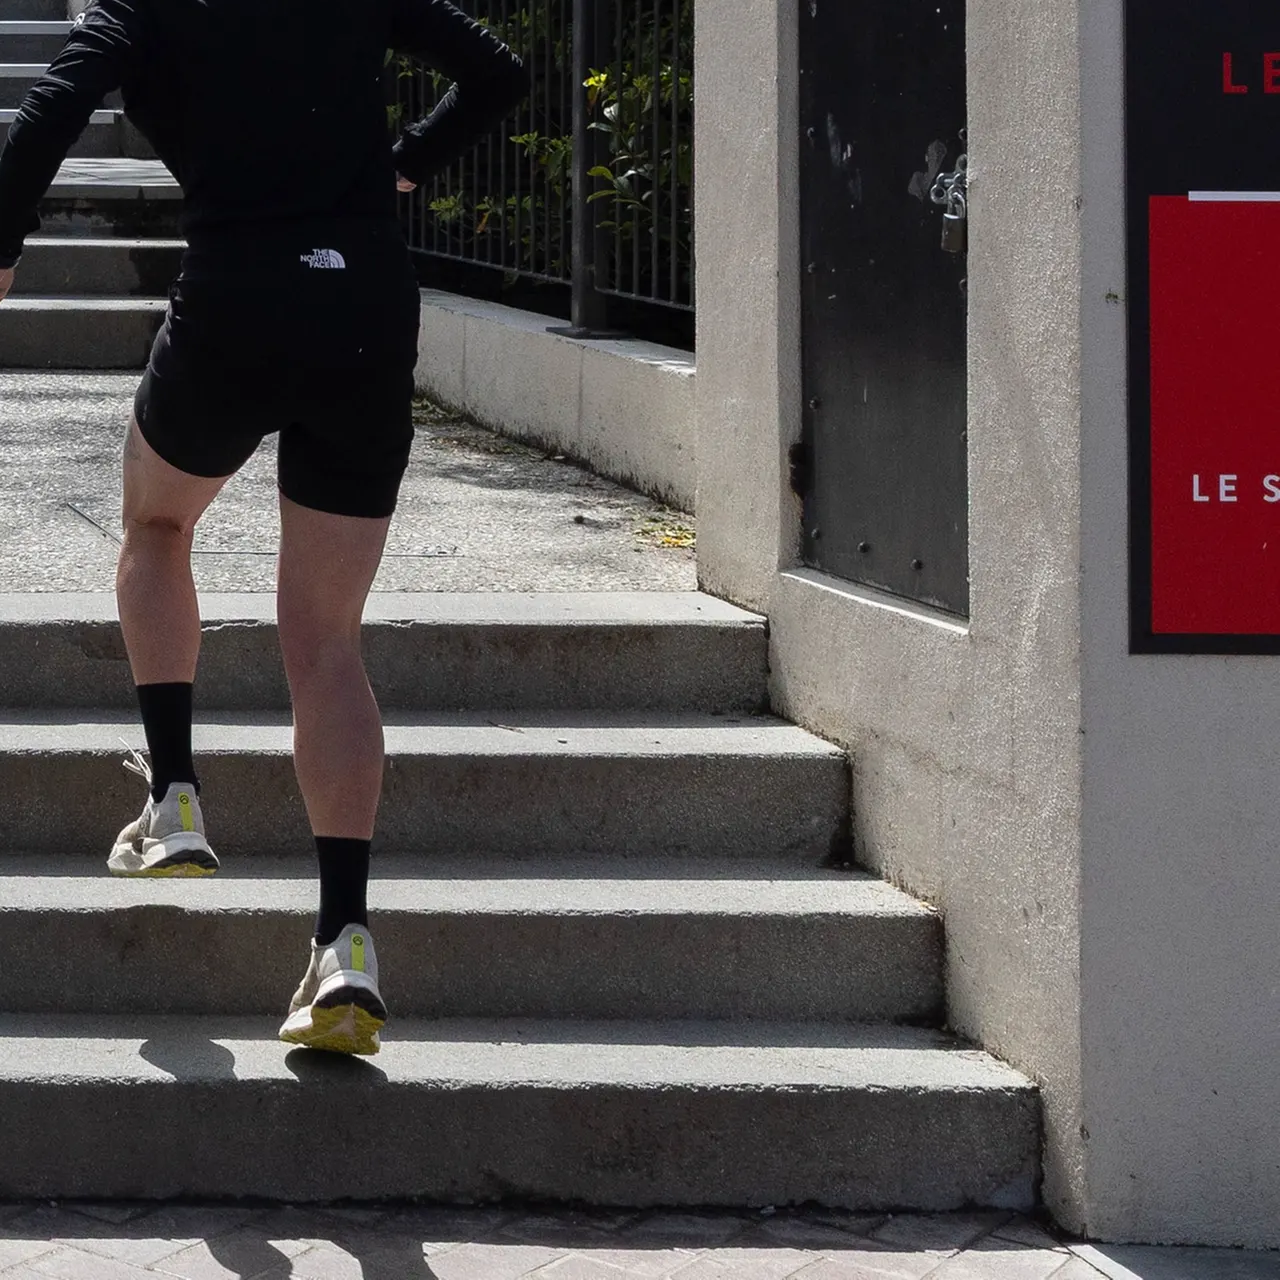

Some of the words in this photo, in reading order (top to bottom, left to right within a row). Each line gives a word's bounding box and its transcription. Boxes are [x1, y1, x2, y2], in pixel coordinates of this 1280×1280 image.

[312, 248, 329, 256] THE
[300, 254, 329, 262] NORTH
[309, 261, 329, 269] FACE
[1192, 474, 1238, 502] LE
